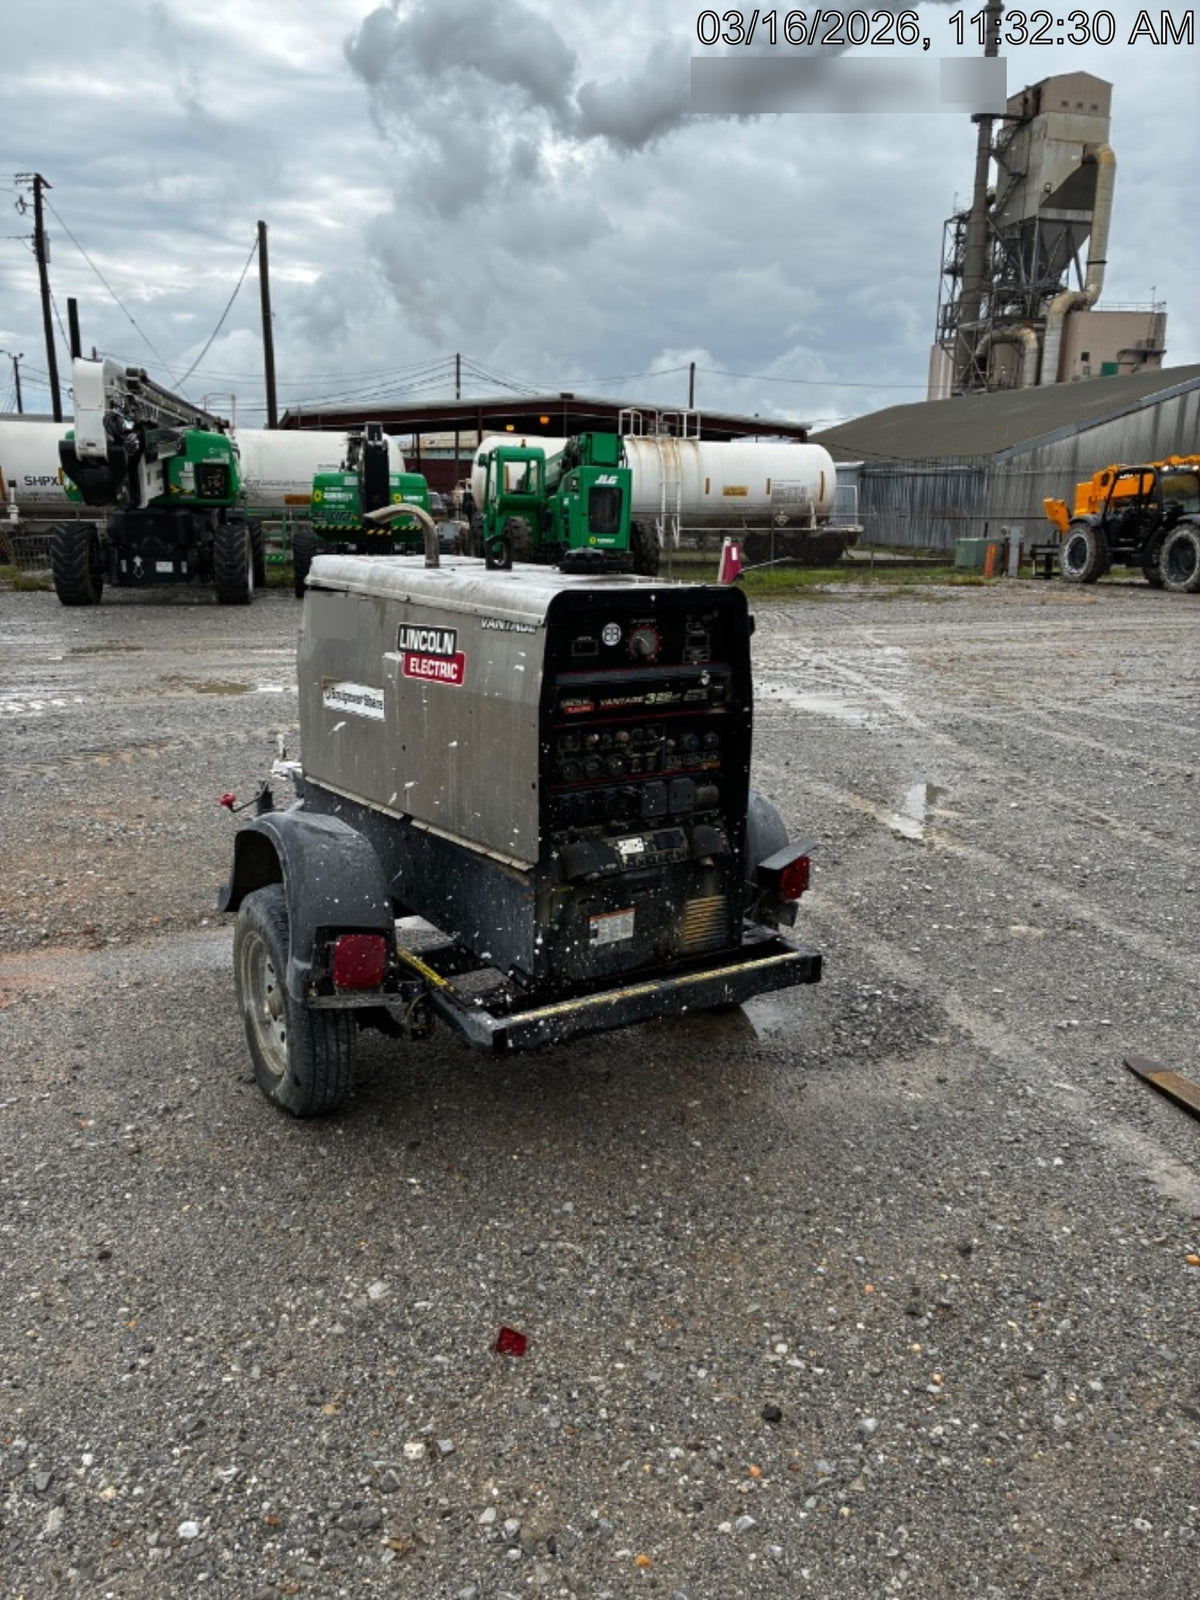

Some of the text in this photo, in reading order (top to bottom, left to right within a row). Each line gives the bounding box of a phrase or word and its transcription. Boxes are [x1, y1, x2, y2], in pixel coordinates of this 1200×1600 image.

[24, 475, 59, 486] SHPX
[595, 473, 619, 485] JLG
[399, 628, 455, 655] LINCOLN
[409, 657, 458, 680] ELECTRIC
